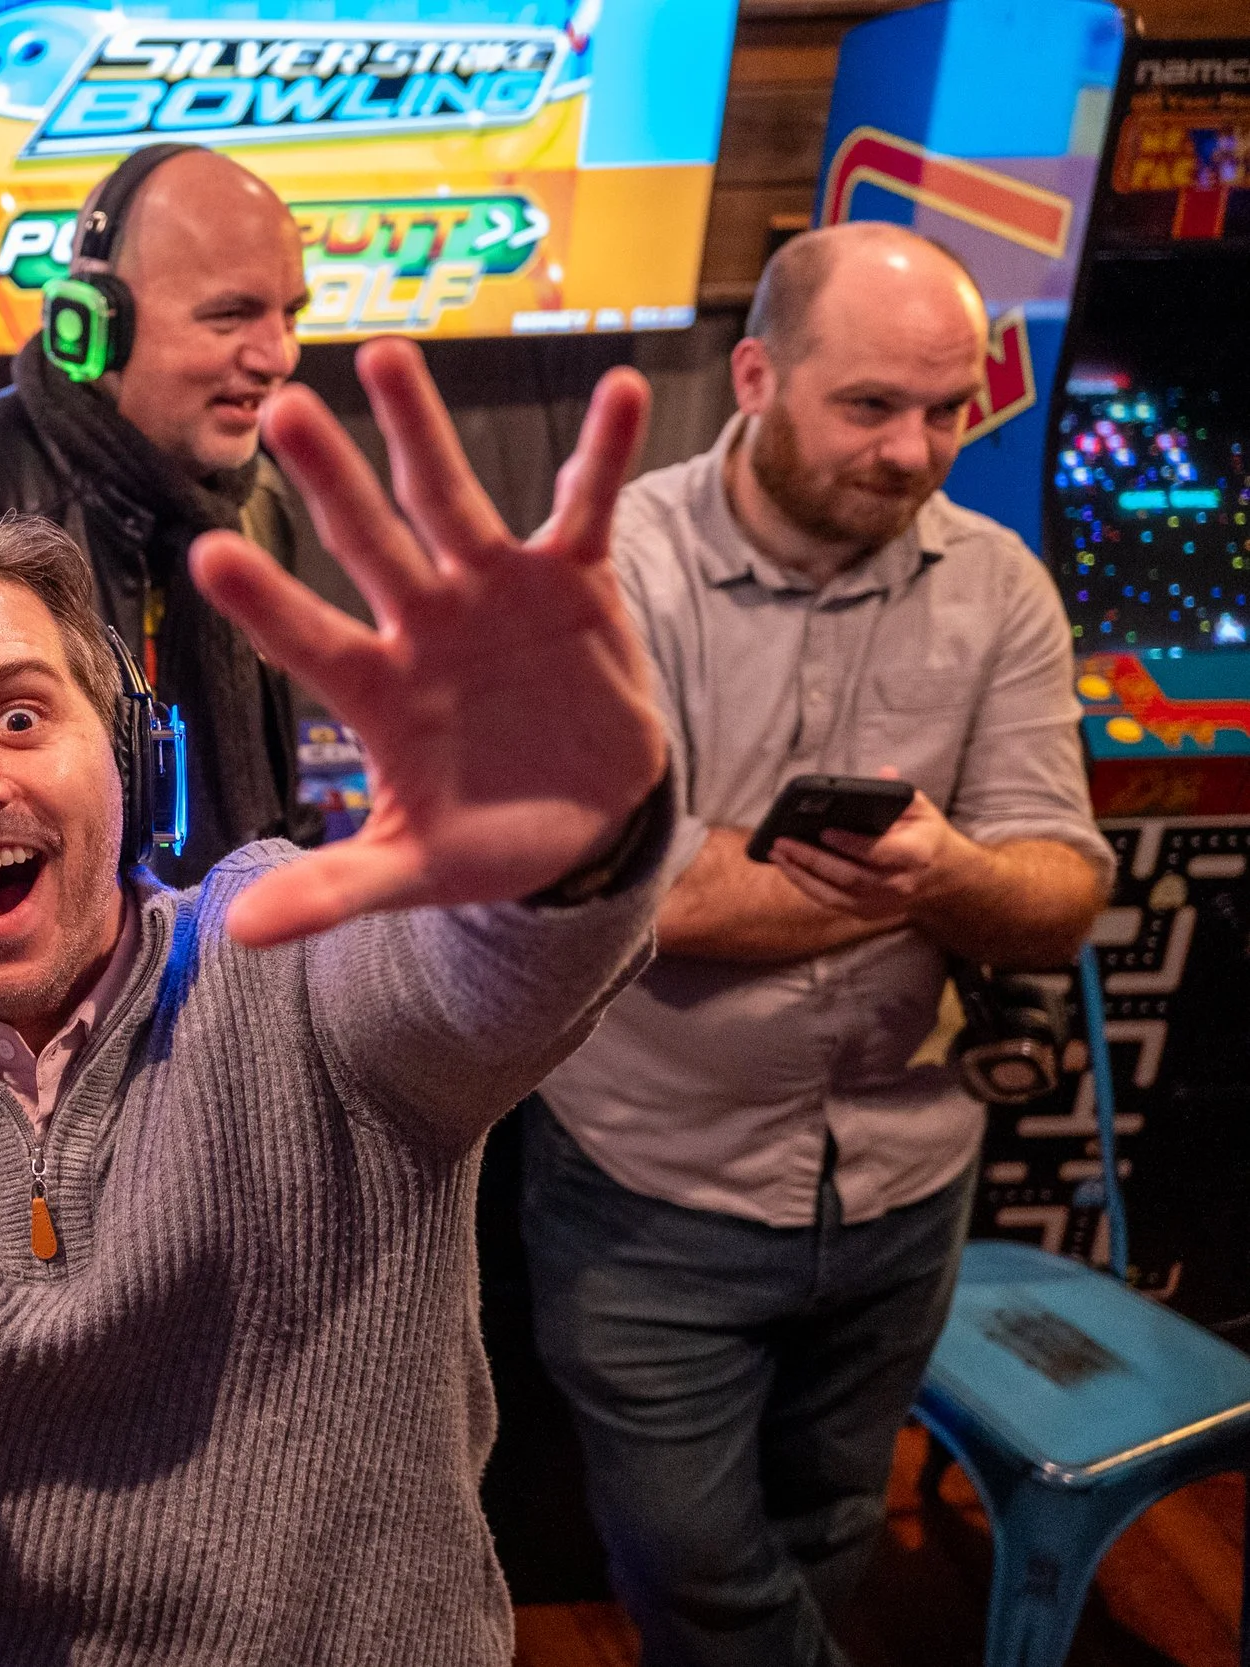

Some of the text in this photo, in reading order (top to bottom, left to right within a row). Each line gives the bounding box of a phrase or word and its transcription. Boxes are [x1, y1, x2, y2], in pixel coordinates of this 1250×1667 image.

[101, 35, 554, 78] SILVER STRIKE
[42, 71, 546, 138] BOWLING
[297, 258, 487, 333] OLF
